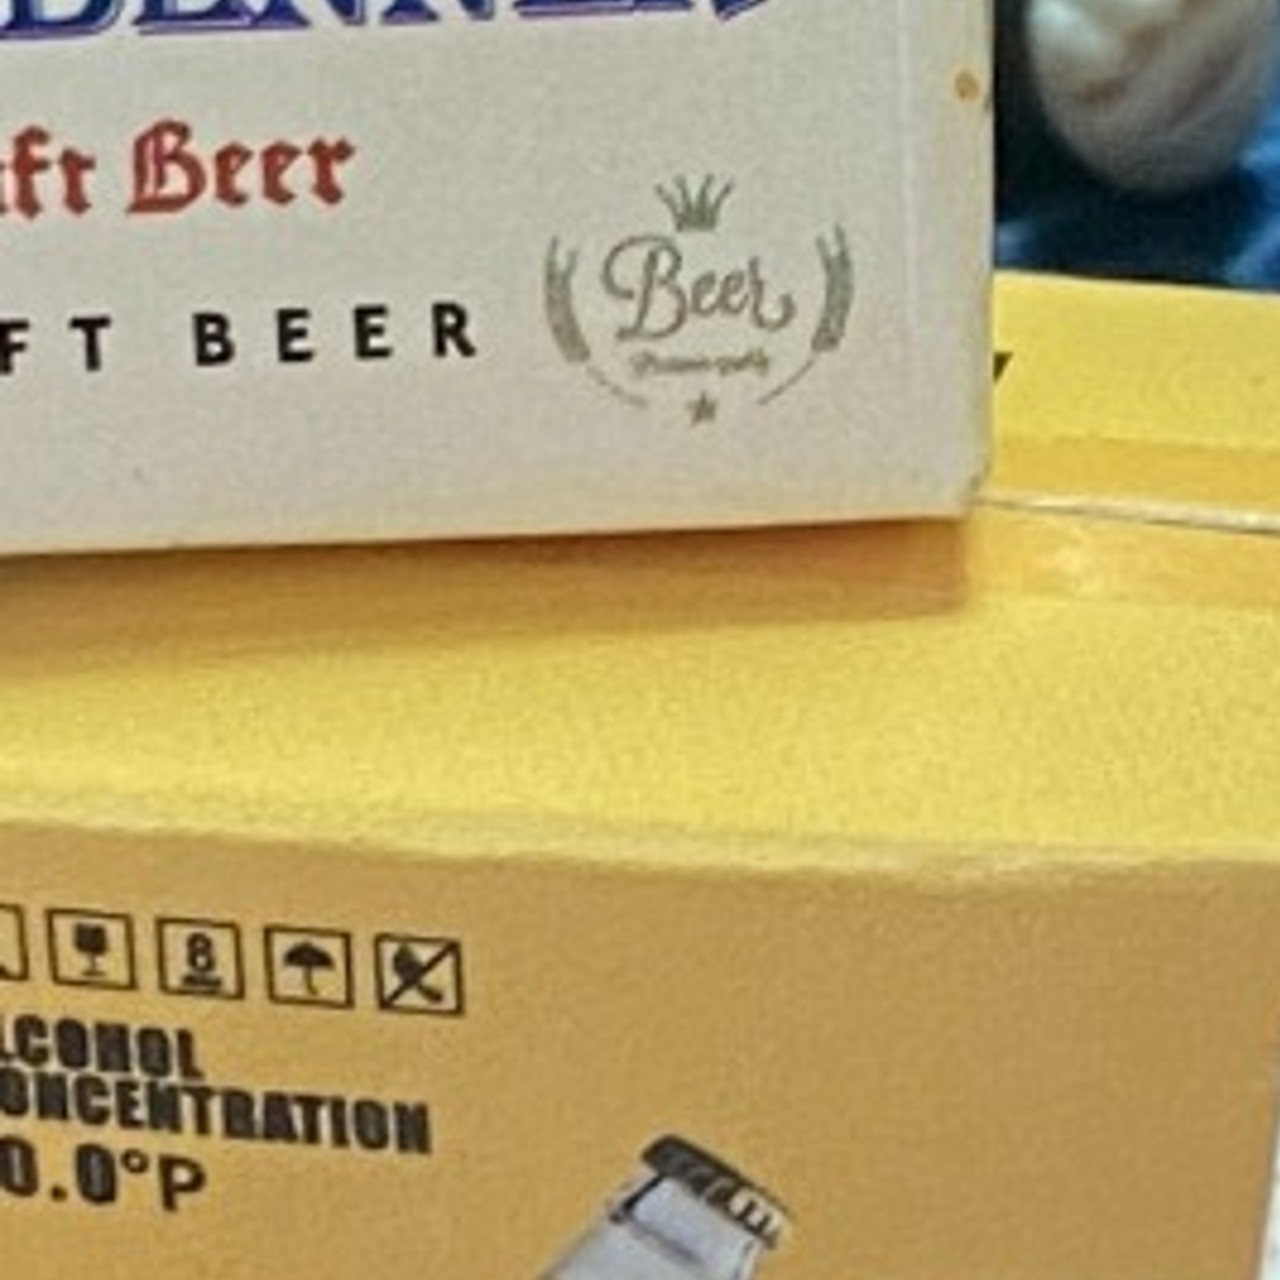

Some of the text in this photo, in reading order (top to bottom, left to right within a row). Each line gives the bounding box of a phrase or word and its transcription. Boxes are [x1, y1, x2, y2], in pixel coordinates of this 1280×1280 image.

[126, 119, 355, 214] Beer
[192, 302, 477, 368] BEER
[600, 234, 796, 341] Beer
